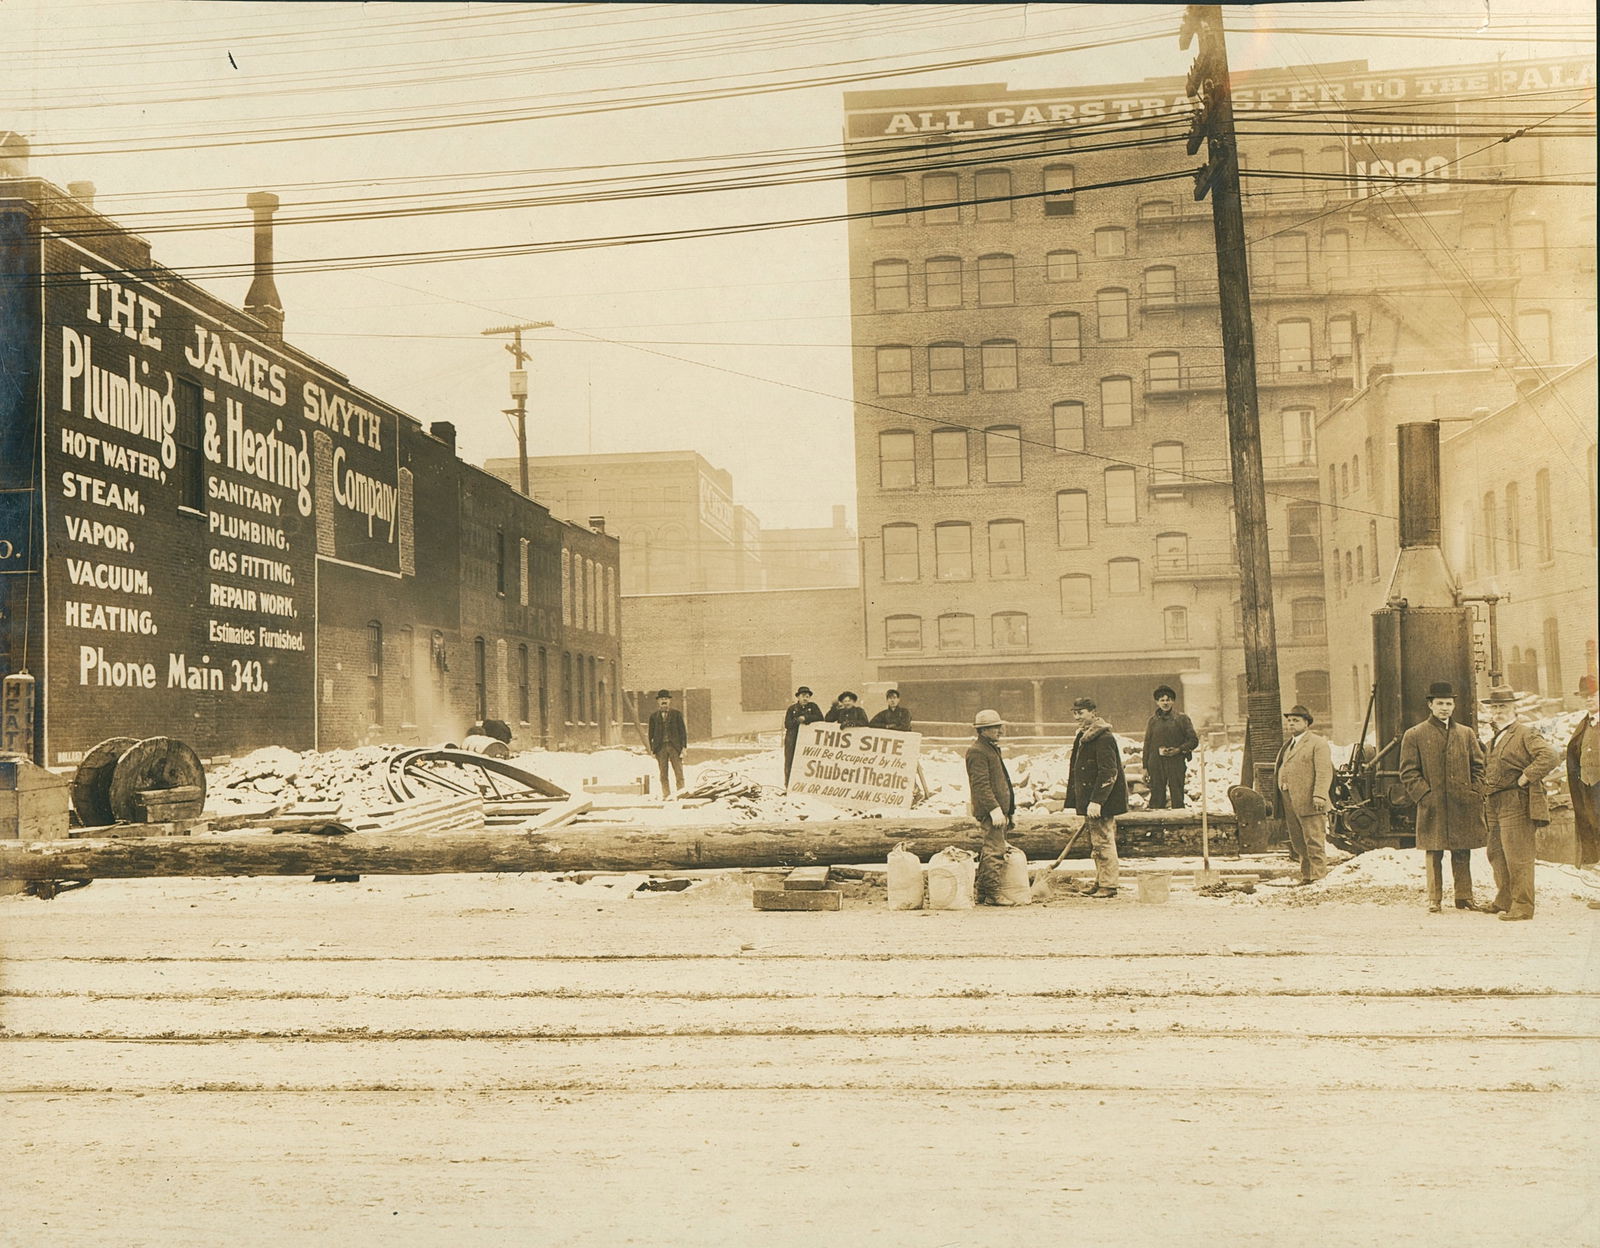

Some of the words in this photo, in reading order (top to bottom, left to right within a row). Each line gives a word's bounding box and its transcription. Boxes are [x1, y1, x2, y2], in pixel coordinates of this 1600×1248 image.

[885, 109, 976, 135] ALL
[987, 100, 1106, 128] CARS
[1109, 83, 1347, 120] TRASFER
[1353, 77, 1406, 101] TO
[1415, 75, 1489, 95] THE
[1351, 125, 1455, 146] ESTABLISHED
[80, 265, 162, 352] THE
[184, 324, 287, 407] JAMES
[302, 381, 382, 452] SMYTH
[61, 325, 177, 470] Plumbing
[203, 411, 222, 464] &
[226, 396, 312, 518] Heating
[332, 446, 398, 544] Company
[61, 427, 101, 462] HOT
[101, 440, 166, 485] WATER,
[62, 471, 146, 517] STEAM,
[208, 475, 283, 517] SANITARY
[64, 515, 135, 554] VAPOR,
[209, 510, 291, 552] PLUMBING,
[209, 548, 238, 574] GAS
[240, 555, 296, 588] FITTING,
[65, 600, 158, 636] HEATING.
[209, 583, 257, 614] REPAIR
[259, 590, 298, 619] WORK,
[209, 620, 255, 647] Estimates
[259, 624, 306, 652] Furnished.
[79, 644, 157, 689] Phone
[167, 653, 224, 692] Main
[231, 659, 269, 694] 343.
[802, 745, 821, 758] Will
[821, 749, 835, 760] Be
[835, 750, 878, 766] Occupied
[879, 757, 890, 768] by
[890, 757, 908, 769] the
[814, 728, 852, 749] THIS
[859, 735, 905, 756] SITE
[792, 782, 805, 792] ON
[807, 783, 821, 795] OR
[820, 785, 852, 799] ABOUT
[851, 789, 873, 803] JAN.
[804, 759, 860, 784] Shubert
[861, 766, 909, 791] Theatre
